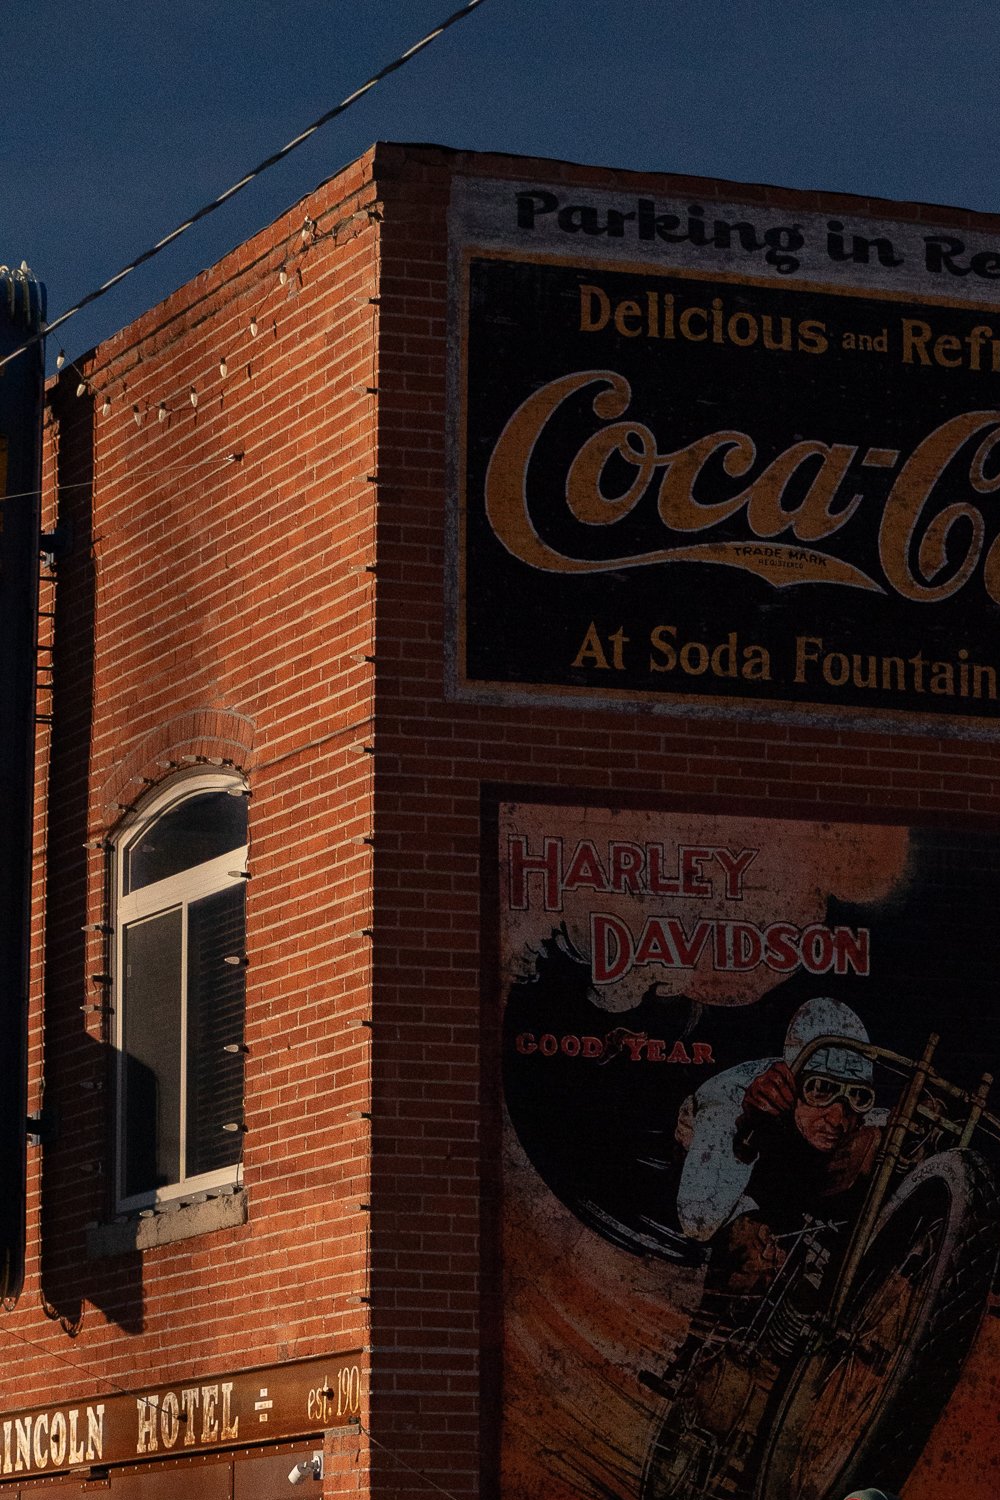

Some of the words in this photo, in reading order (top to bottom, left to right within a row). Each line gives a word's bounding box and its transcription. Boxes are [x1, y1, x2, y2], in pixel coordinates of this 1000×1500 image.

[516, 190, 809, 274] Parking
[827, 220, 903, 268] in
[579, 282, 831, 356] Delicious
[841, 324, 890, 355] and
[734, 547, 782, 558] TRADE
[789, 550, 827, 567] MARK
[571, 621, 631, 672] At
[648, 622, 774, 684] Soda
[508, 833, 760, 911] HARLEY
[590, 911, 871, 987] DAVIDSON
[0, 1404, 105, 1474] INCOLN
[136, 1382, 239, 1454] HOTEL
[336, 1365, 361, 1417] 190
